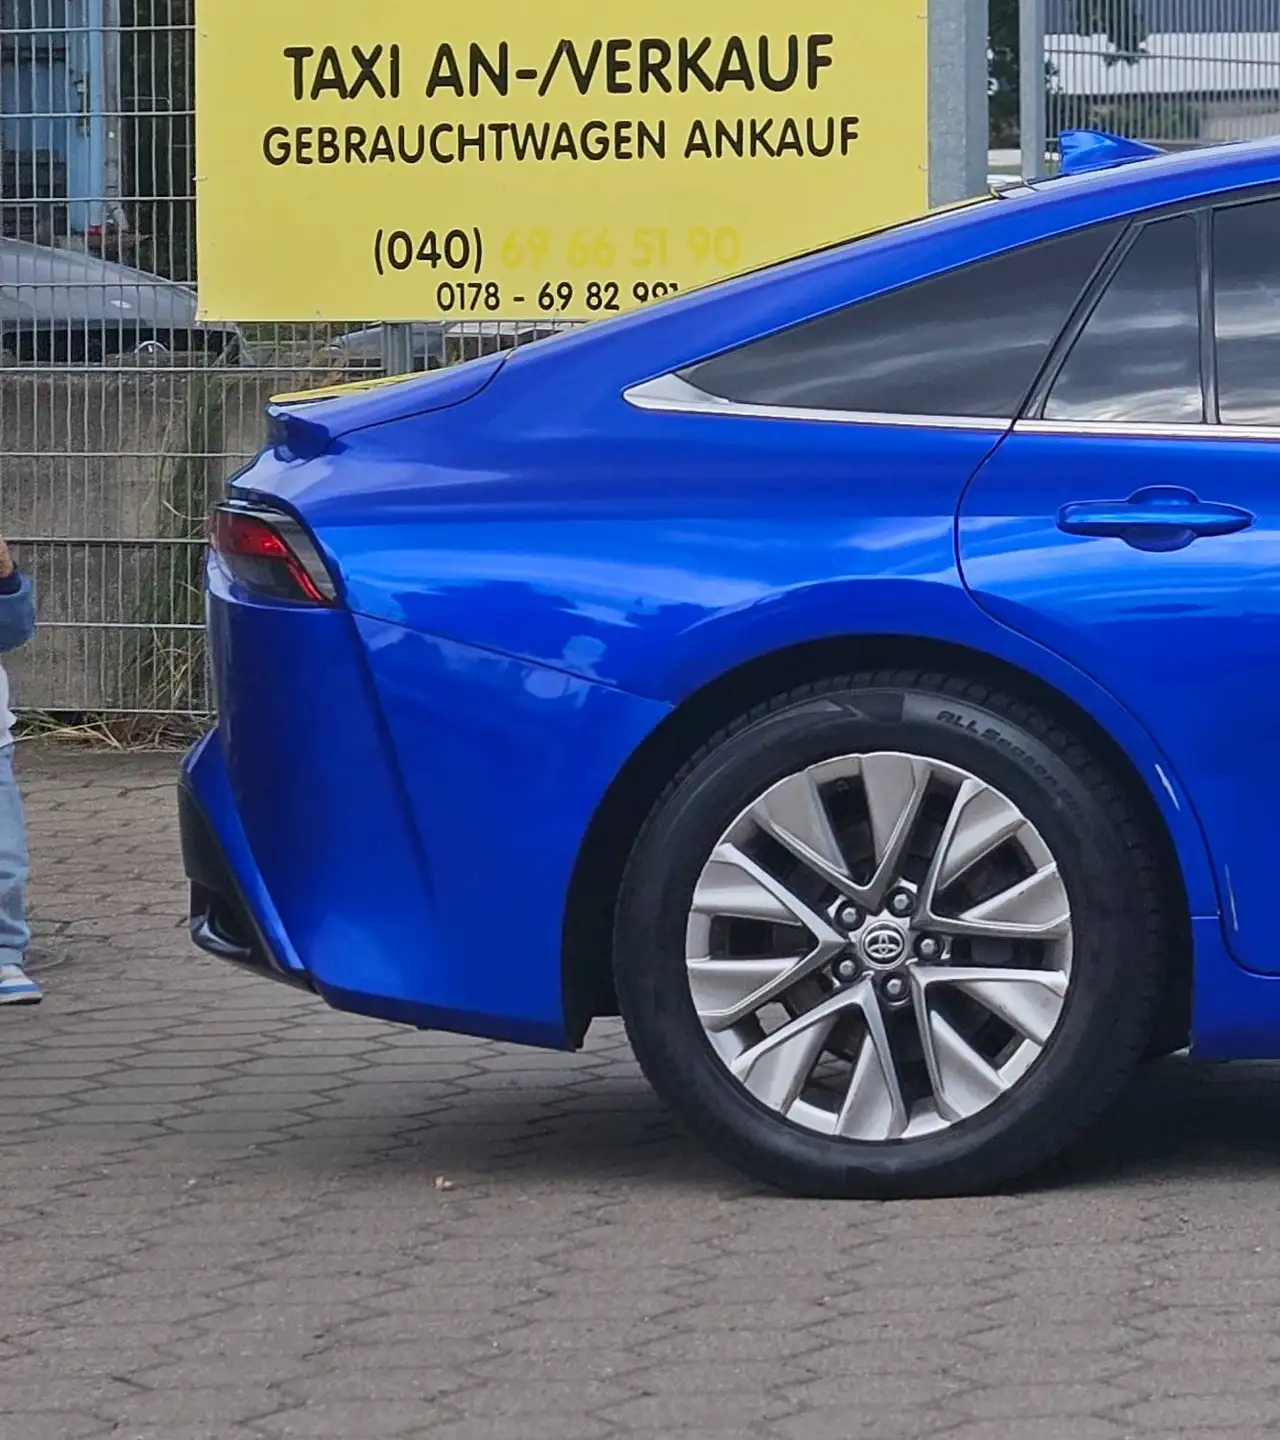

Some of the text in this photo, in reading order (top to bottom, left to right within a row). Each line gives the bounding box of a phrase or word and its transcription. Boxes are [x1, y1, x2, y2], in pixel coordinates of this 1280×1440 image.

[283, 44, 401, 101] TAXI
[262, 116, 860, 166] GEBRAUCHTWAGEN ANKAUF
[373, 225, 741, 276] (040) 69 66 51 90
[436, 281, 501, 312] 0178
[537, 281, 574, 311] 69
[586, 281, 621, 311] 82
[936, 710, 979, 735] ALL
